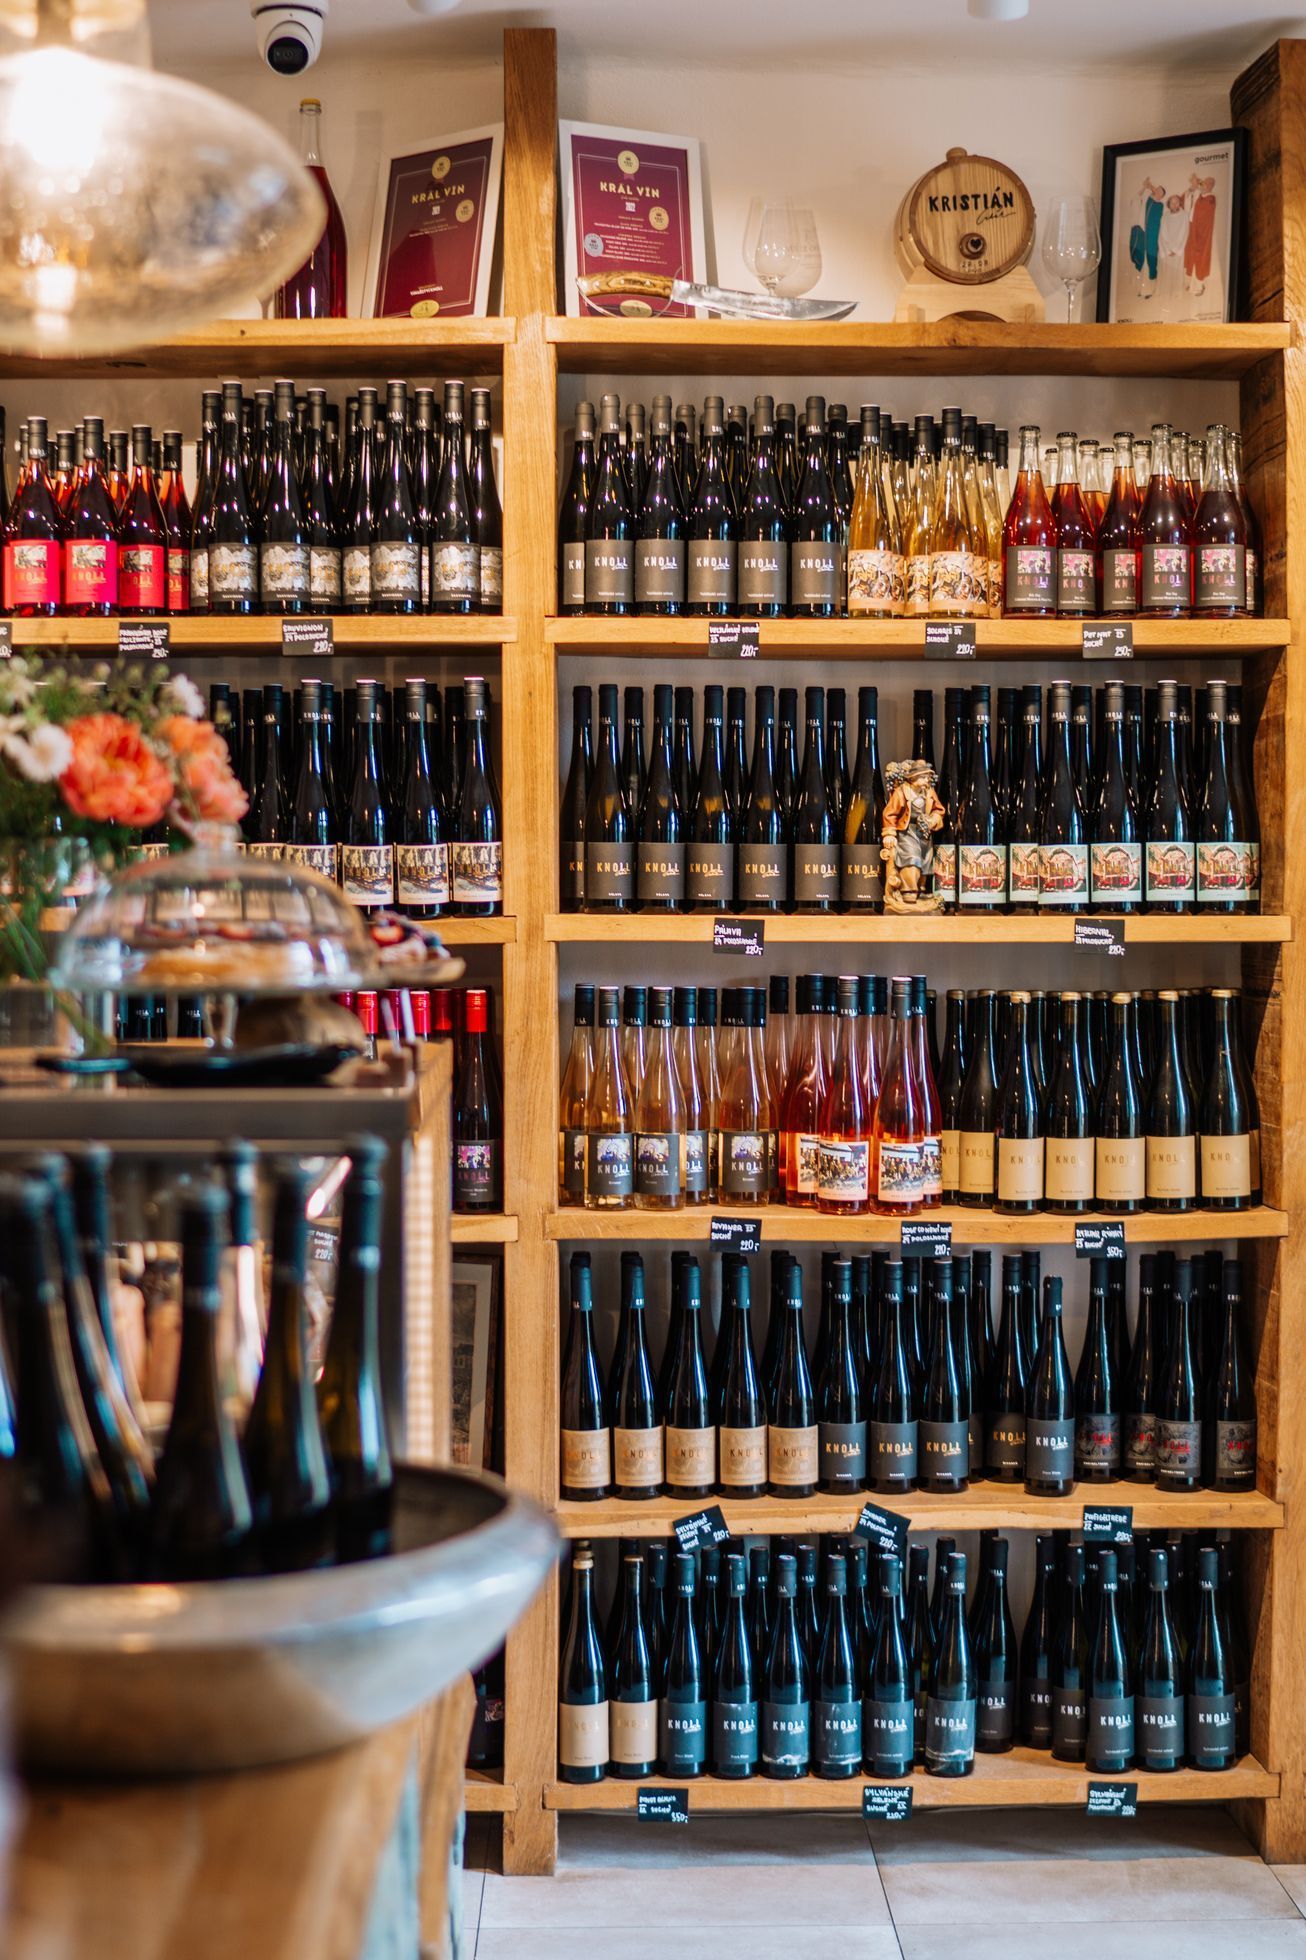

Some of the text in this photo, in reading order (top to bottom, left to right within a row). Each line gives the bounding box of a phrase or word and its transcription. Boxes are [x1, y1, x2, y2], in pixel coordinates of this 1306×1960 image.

[1194, 152, 1229, 164] gourmet
[928, 186, 1014, 213] KRISTIÁN
[595, 557, 627, 567] KNOLL
[644, 557, 678, 567] KNOLL
[697, 556, 730, 567] KNOLL
[744, 558, 778, 568] KNOLL
[800, 558, 834, 568] KNOLL
[597, 862, 630, 873] KNOLL
[645, 862, 680, 873] KNOLL
[690, 863, 724, 874] KNOLL
[745, 863, 780, 875] KNOLL
[804, 863, 838, 875] KNOLL
[714, 924, 742, 936] PÁLAVA
[597, 1164, 630, 1174] KNOLL
[731, 1161, 763, 1172] KNOLL
[1036, 1436, 1068, 1447] KNOLL
[826, 1443, 860, 1453] KNOLL
[879, 1442, 913, 1453] KNOLL
[926, 1442, 961, 1453] KNOLL
[668, 1718, 701, 1729] KNOLL
[874, 1718, 907, 1729] KNOLL
[935, 1716, 968, 1728] KNOLL
[1101, 1715, 1132, 1727] KNOLL
[1143, 1713, 1177, 1725] KNOLL
[1199, 1712, 1231, 1724] KNOLL
[723, 1718, 755, 1730] KNOLL
[773, 1720, 806, 1731] KNOLL
[826, 1718, 858, 1730] KNOLL
